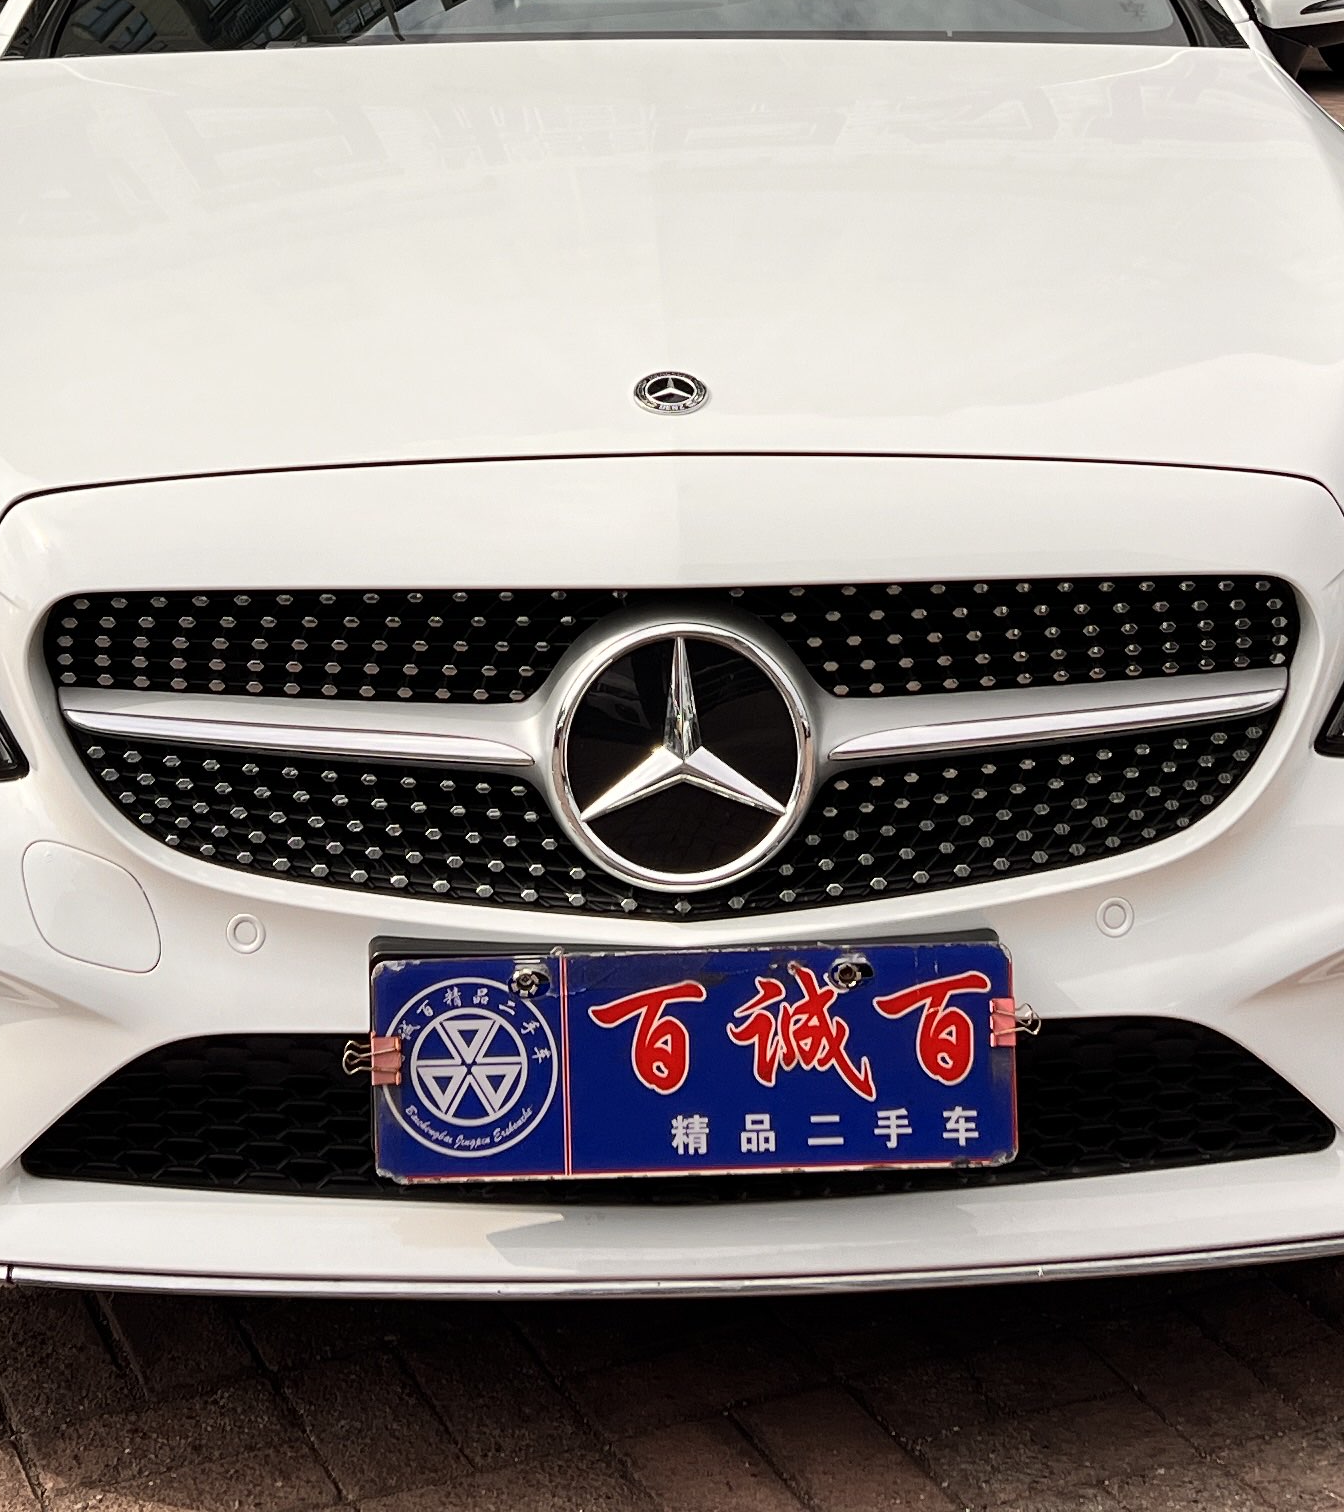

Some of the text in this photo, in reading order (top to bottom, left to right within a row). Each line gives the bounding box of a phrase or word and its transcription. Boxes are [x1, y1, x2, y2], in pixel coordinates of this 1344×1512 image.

[589, 962, 993, 1101] 百诚百
[670, 1106, 980, 1157] 精品二手车
